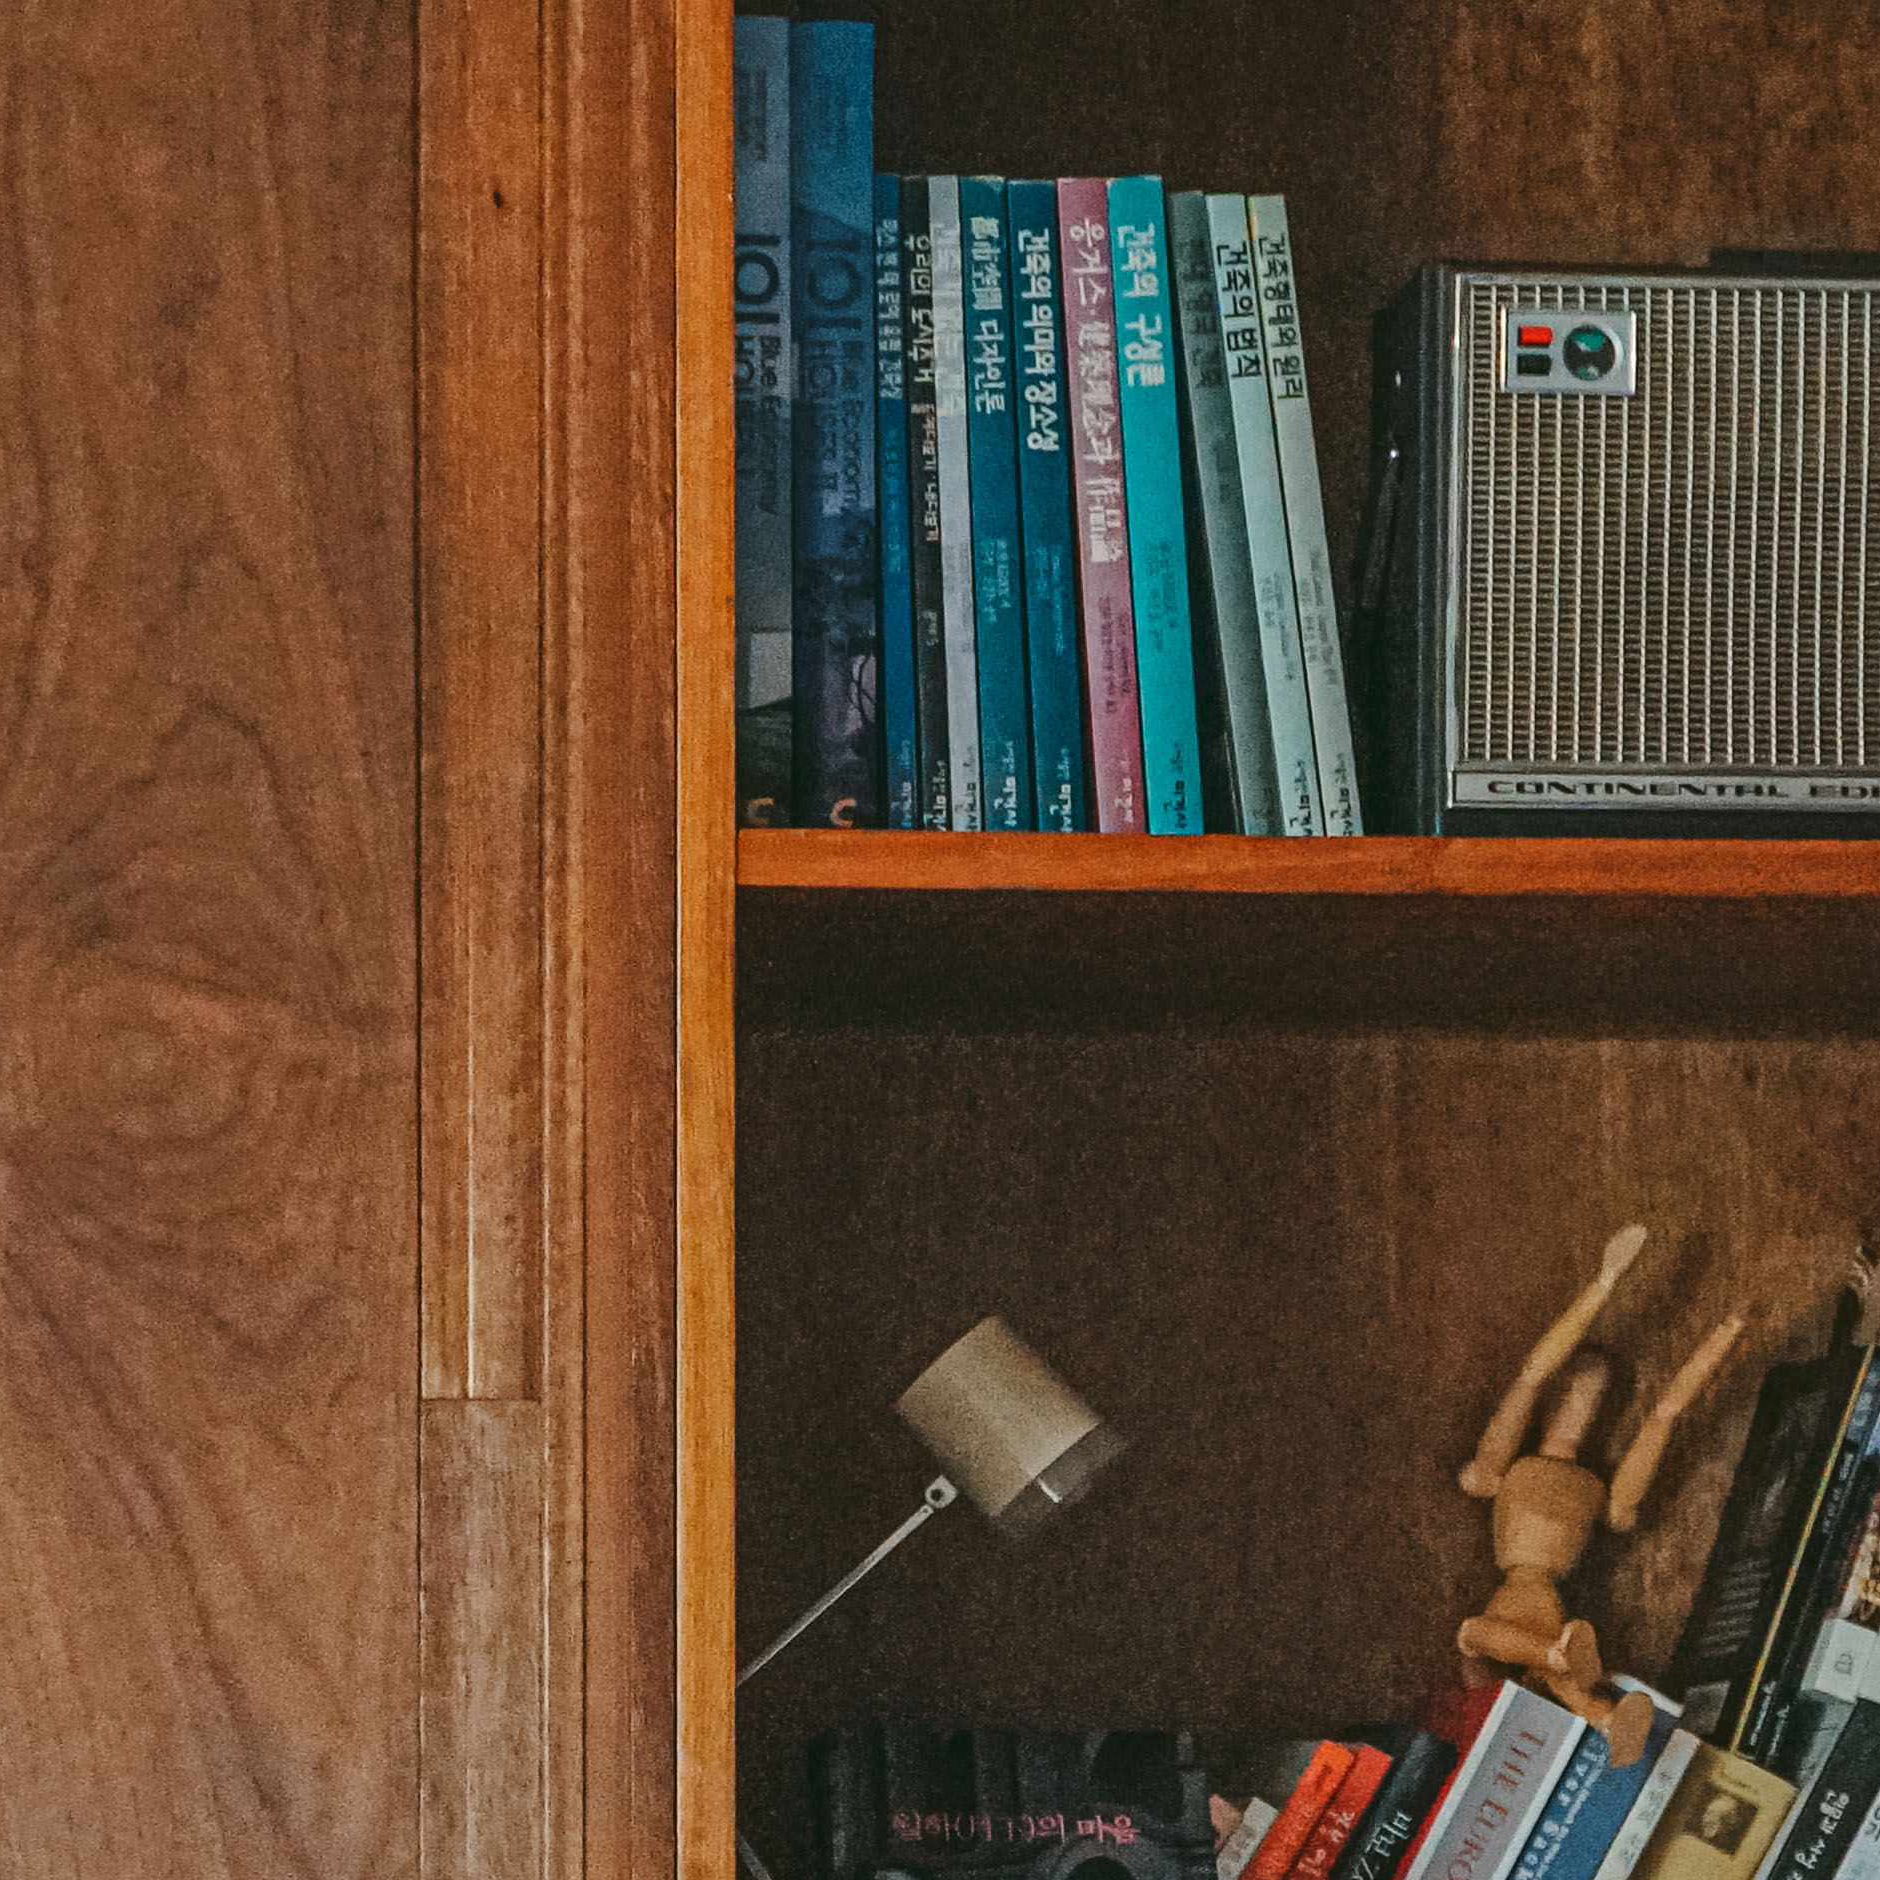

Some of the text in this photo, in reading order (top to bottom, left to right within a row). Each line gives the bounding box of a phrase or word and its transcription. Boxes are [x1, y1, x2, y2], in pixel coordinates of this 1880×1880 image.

[909, 233, 932, 295] 우리의
[1018, 227, 1060, 451] 건축의 의미와 장소성
[1120, 221, 1170, 389] 건축의 구성론
[1213, 239, 1263, 380] 건축의 법칙
[1257, 231, 1307, 401] 건축형태와 원리
[972, 318, 1004, 415] 디자인론
[1491, 1720, 1549, 1796] THE
[1075, 1814, 1137, 1844] 마음
[1363, 1804, 1418, 1868] 바보
[1811, 1786, 1852, 1838] 인물과
[1792, 1831, 1828, 1871] 사상
